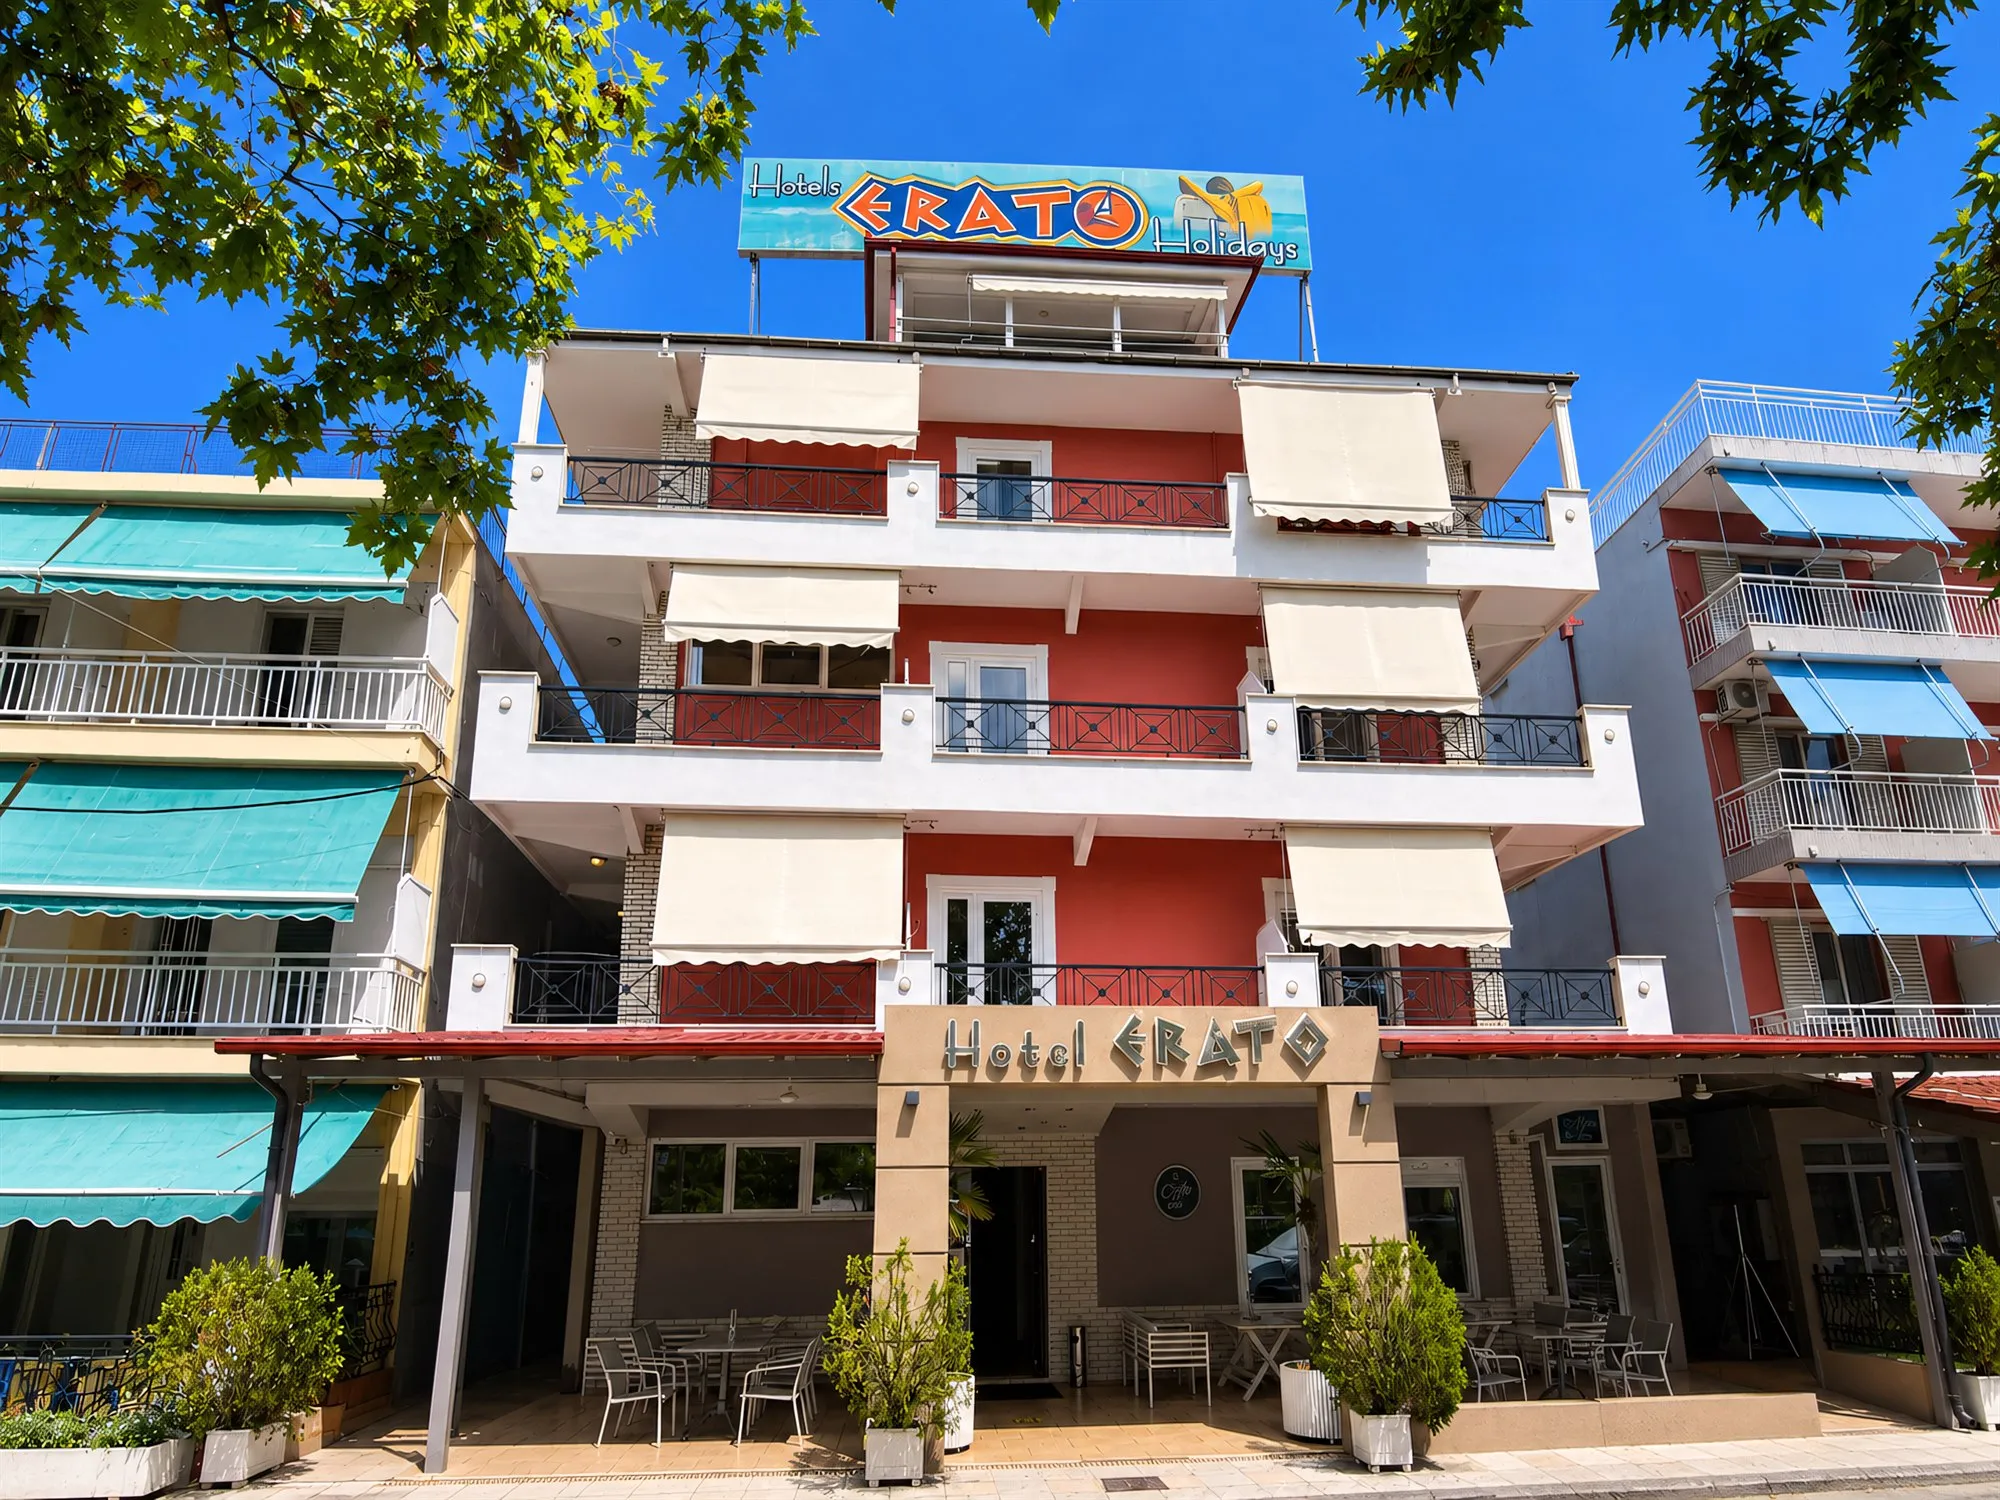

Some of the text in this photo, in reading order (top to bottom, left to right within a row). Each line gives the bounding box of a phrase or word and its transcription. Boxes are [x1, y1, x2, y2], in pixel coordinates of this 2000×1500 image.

[748, 162, 842, 199] Hotels
[845, 181, 1136, 240] ERATO
[1152, 216, 1299, 266] Holidays
[945, 1011, 1330, 1069] Hotel ERATO
